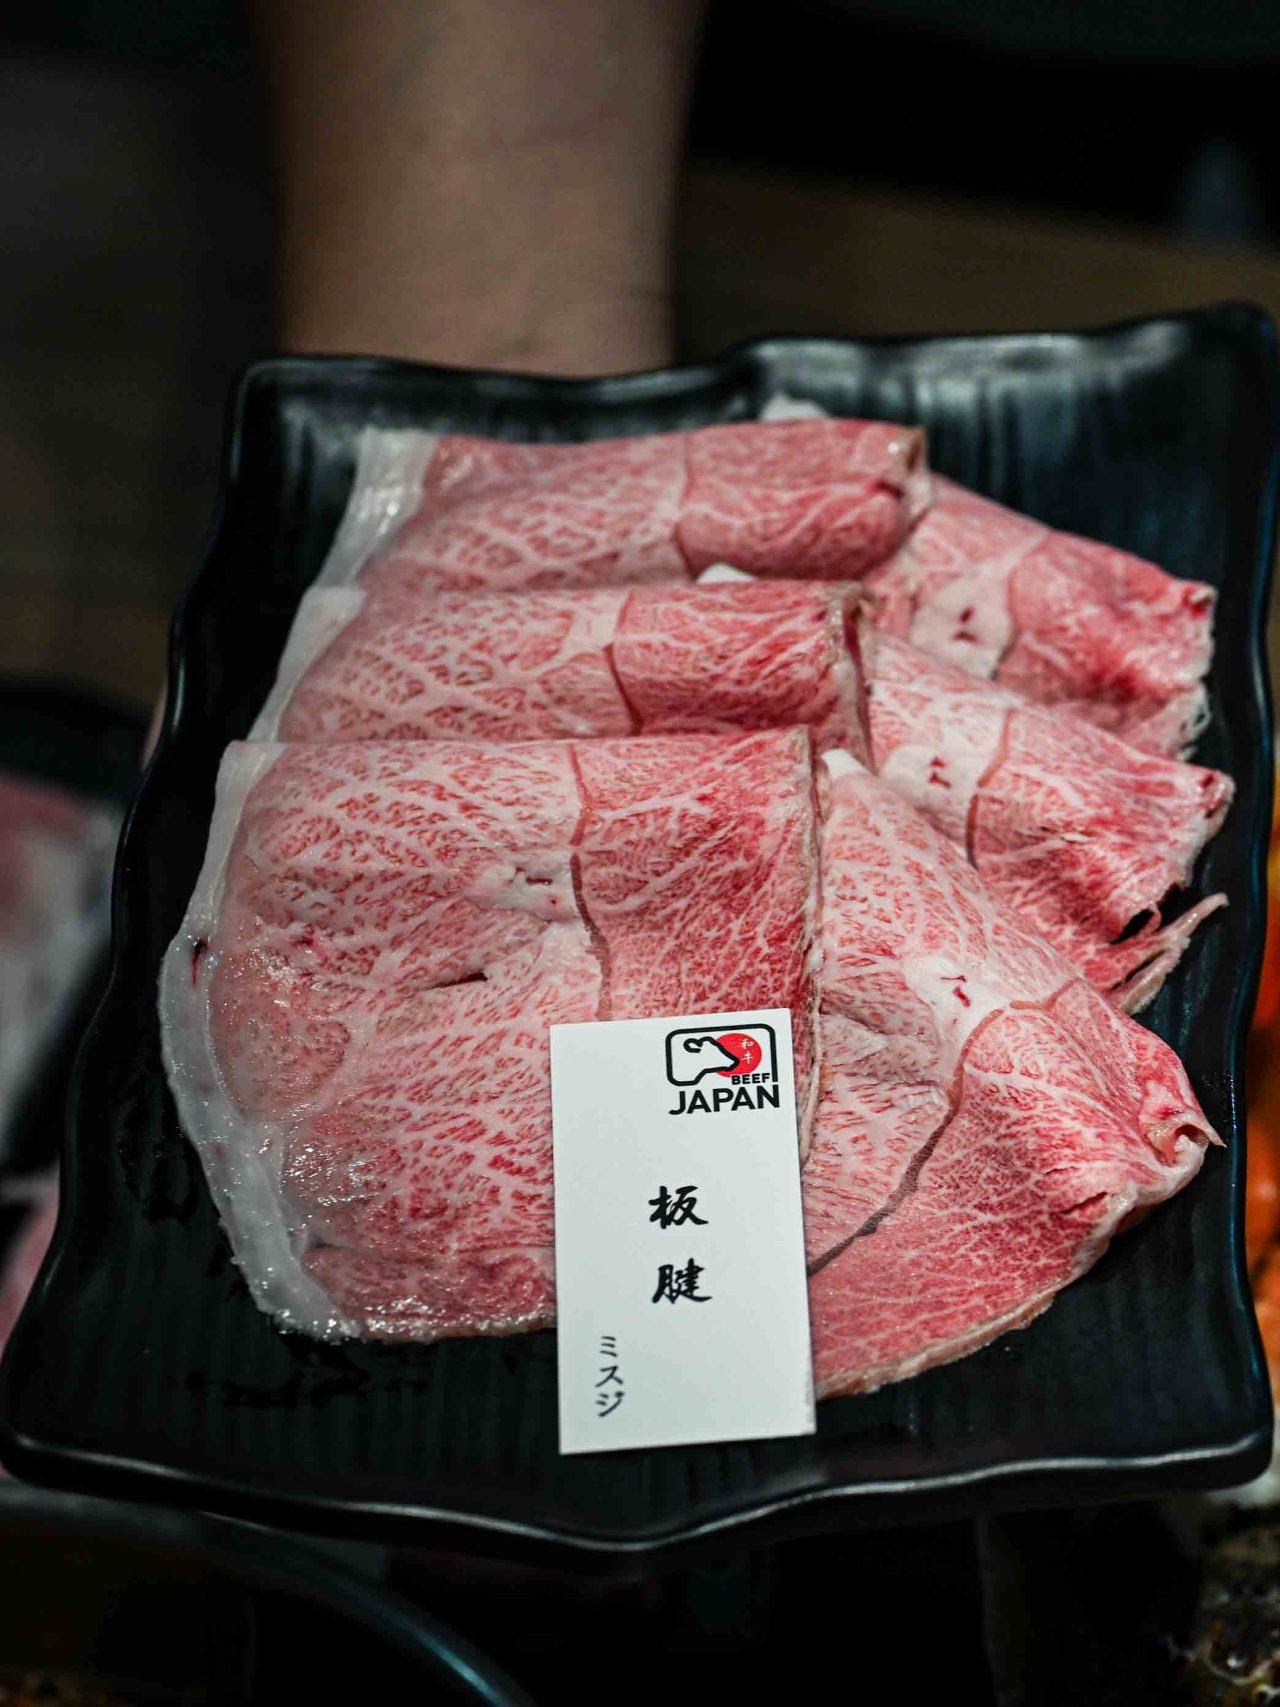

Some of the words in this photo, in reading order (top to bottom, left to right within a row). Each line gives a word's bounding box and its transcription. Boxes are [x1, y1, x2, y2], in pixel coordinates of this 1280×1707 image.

[738, 1038, 755, 1065] 和牛
[731, 1072, 771, 1085] BEEF
[668, 1084, 780, 1115] JAPAN
[648, 1185, 712, 1304] 板腱
[595, 1336, 624, 1418] ミスジ
